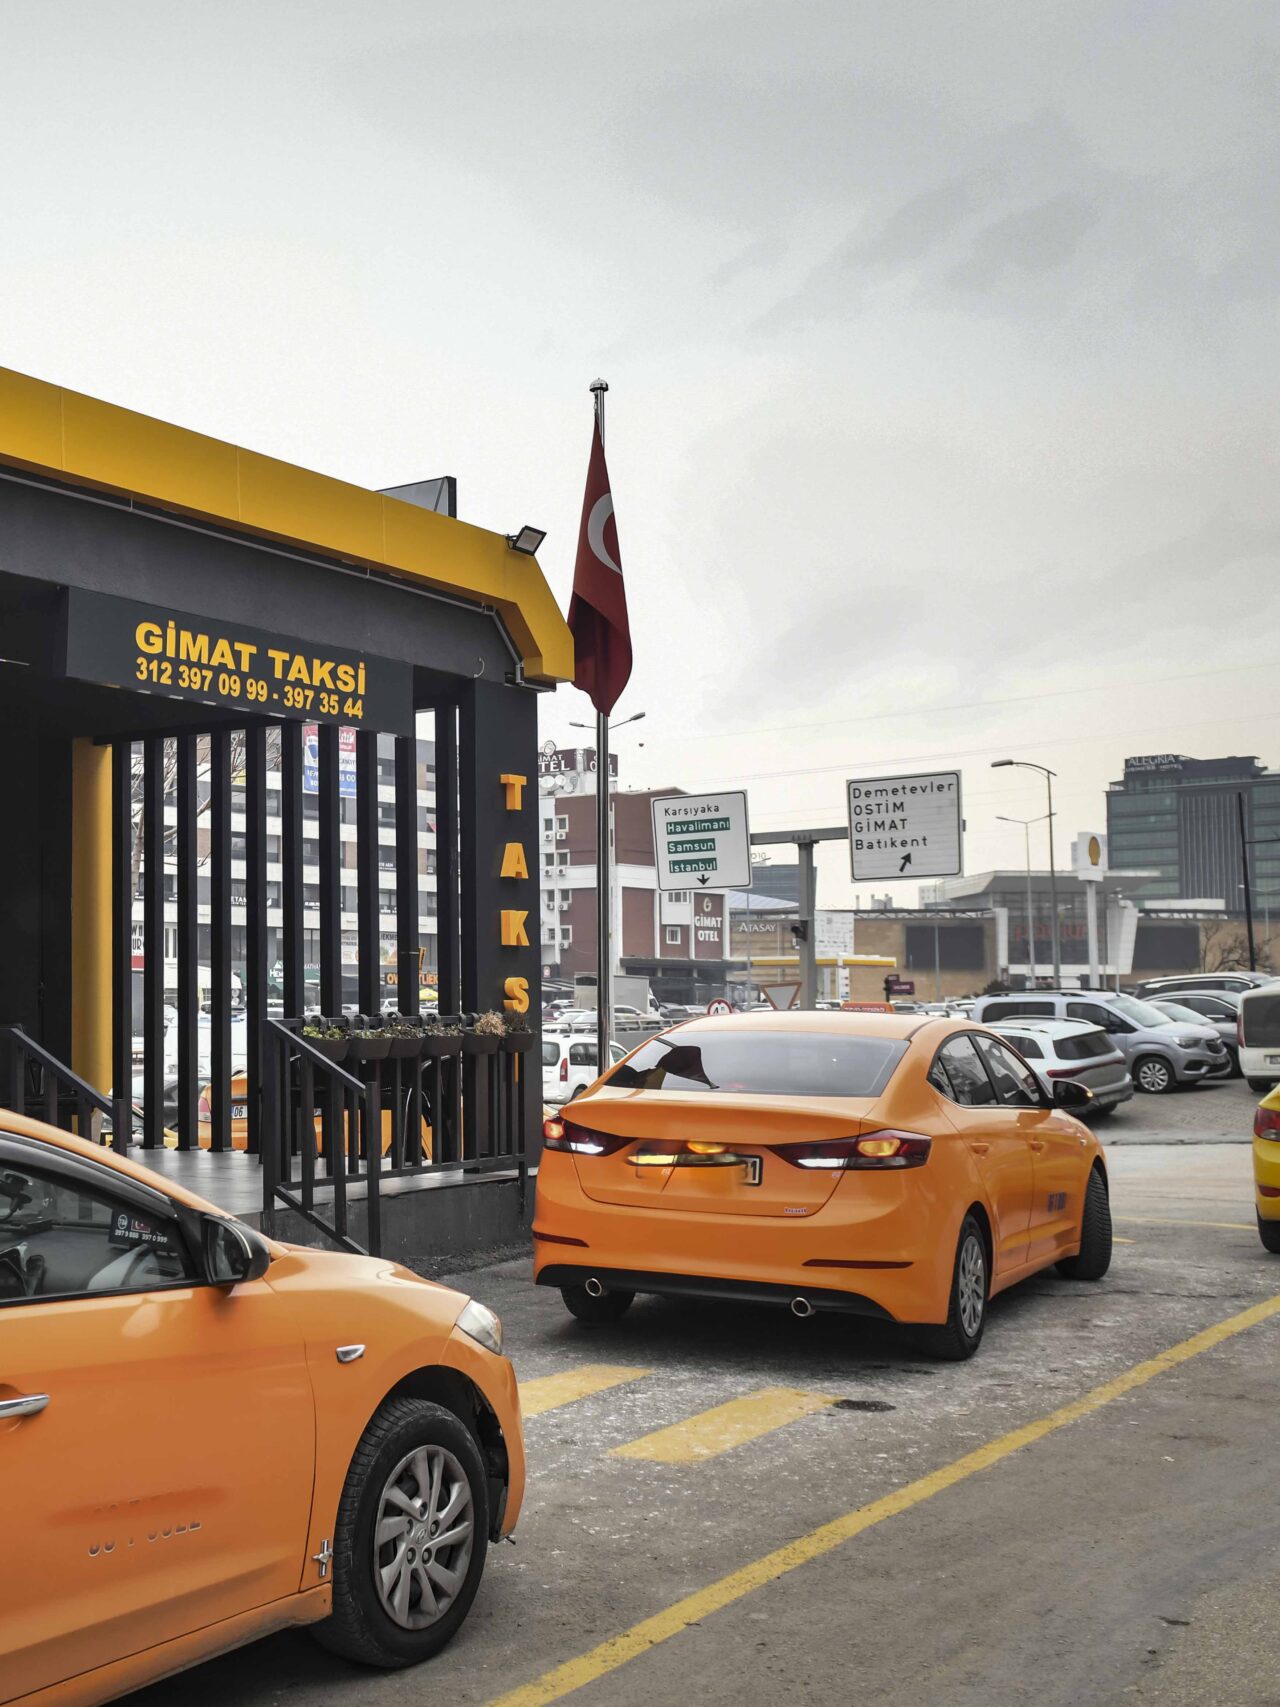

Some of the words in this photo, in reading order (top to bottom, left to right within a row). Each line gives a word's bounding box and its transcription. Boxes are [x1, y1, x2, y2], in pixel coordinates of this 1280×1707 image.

[135, 619, 257, 673] GİMAT
[267, 648, 367, 695] TAKSİ
[135, 656, 172, 685] 312
[178, 664, 213, 692] 397
[218, 673, 241, 698] 09
[246, 678, 268, 702] 99
[283, 685, 315, 711] 397
[319, 691, 339, 715] 35
[343, 696, 364, 719] 44
[538, 760, 571, 773] TEL
[852, 781, 955, 799] Demetevler
[664, 804, 720, 816] Karşıyaka
[853, 800, 905, 816] OSTİM
[666, 820, 730, 833] Havalimanı
[854, 818, 908, 833] GİMAT
[668, 842, 715, 852] Samsun
[855, 836, 928, 850] Batıkent
[669, 860, 717, 873] İstanbul
[499, 774, 531, 1014] TAKS
[695, 913, 722, 928] GİMAT
[739, 922, 776, 932] ATASAY
[698, 930, 719, 941] OTEL
